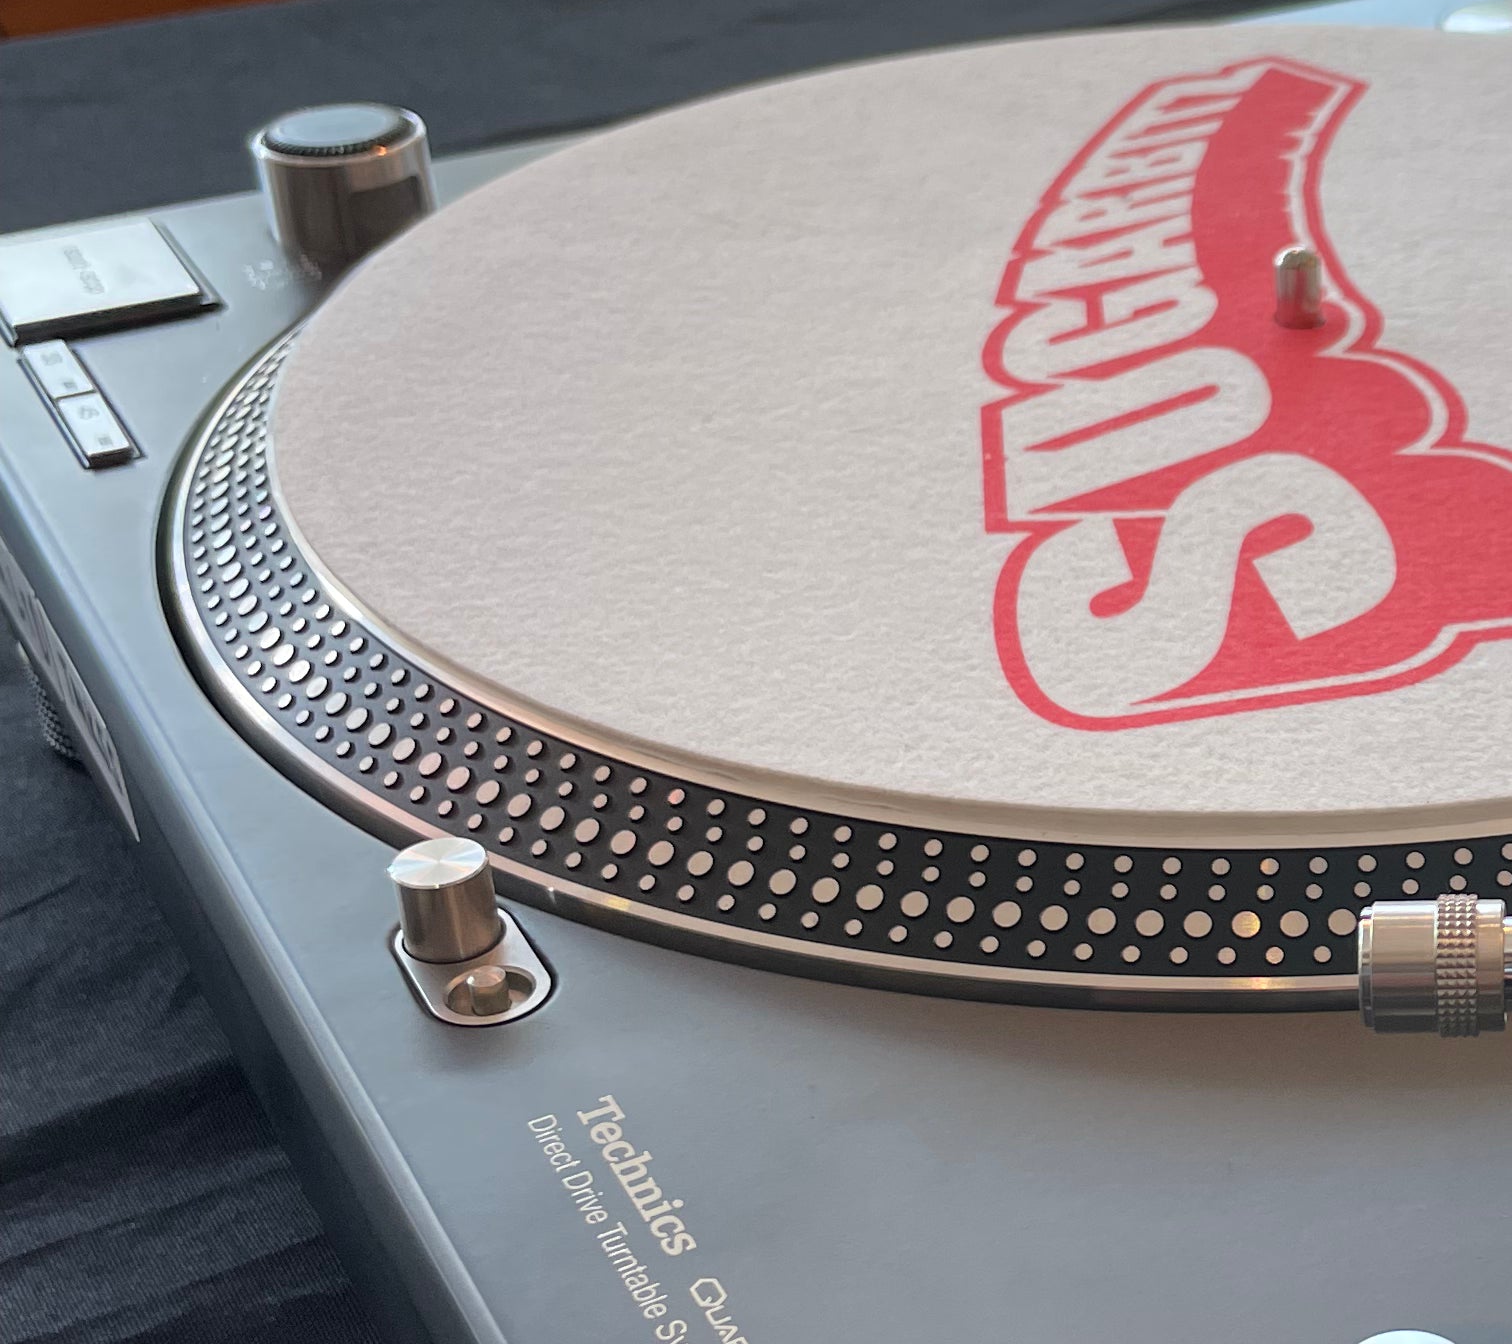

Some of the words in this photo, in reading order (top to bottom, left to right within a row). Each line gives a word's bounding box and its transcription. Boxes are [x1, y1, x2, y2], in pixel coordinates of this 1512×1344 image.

[996, 60, 1400, 720] SUGARBITZ
[527, 1114, 581, 1173] Direct
[561, 1170, 609, 1225] Drive
[596, 1221, 668, 1320] Turntable
[576, 1094, 698, 1256] Technics
